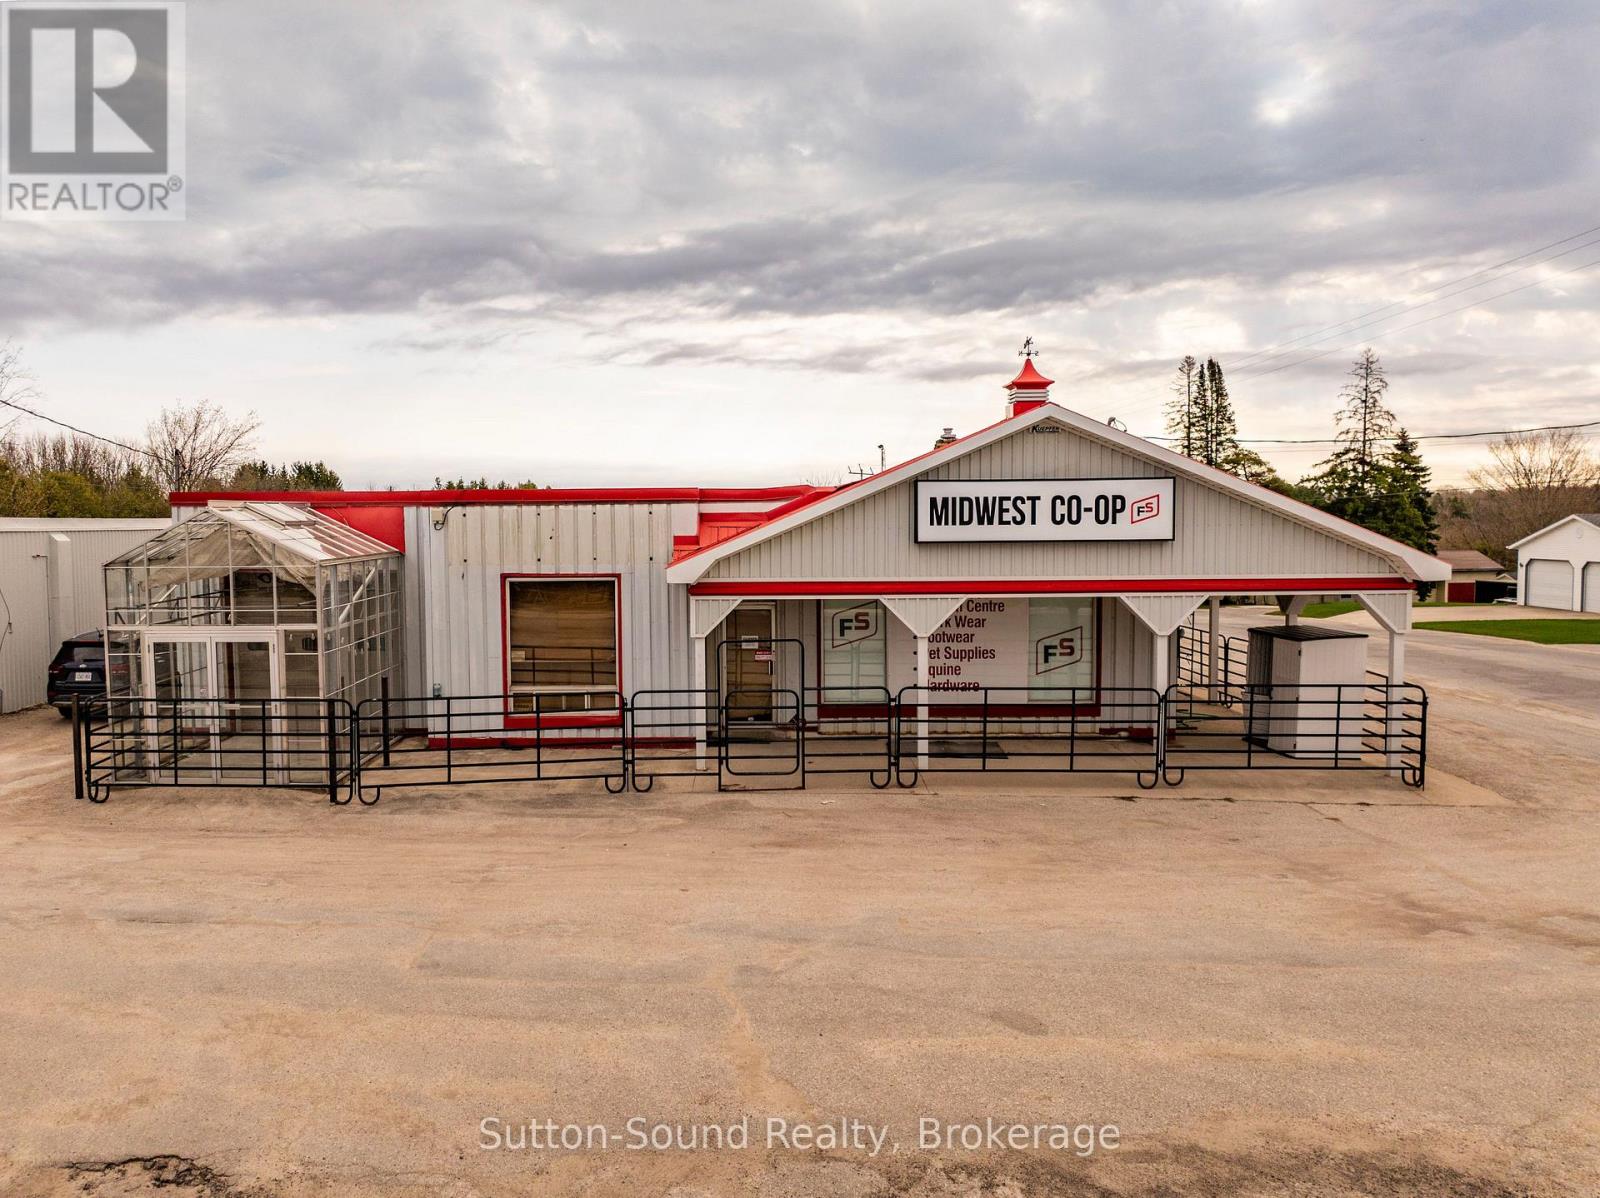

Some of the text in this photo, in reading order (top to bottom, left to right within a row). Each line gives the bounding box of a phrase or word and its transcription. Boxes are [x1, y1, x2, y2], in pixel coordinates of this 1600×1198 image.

[929, 494, 1126, 526] MIDWEST CO-OP
[1137, 502, 1154, 517] FS
[966, 599, 1005, 612] Centre
[840, 611, 870, 637] FS
[954, 615, 987, 628] Wear
[928, 631, 975, 643] ootwear
[928, 646, 996, 662] et Supplies
[1043, 637, 1075, 664] FS
[928, 662, 961, 678] quine
[928, 679, 980, 692] ardware
